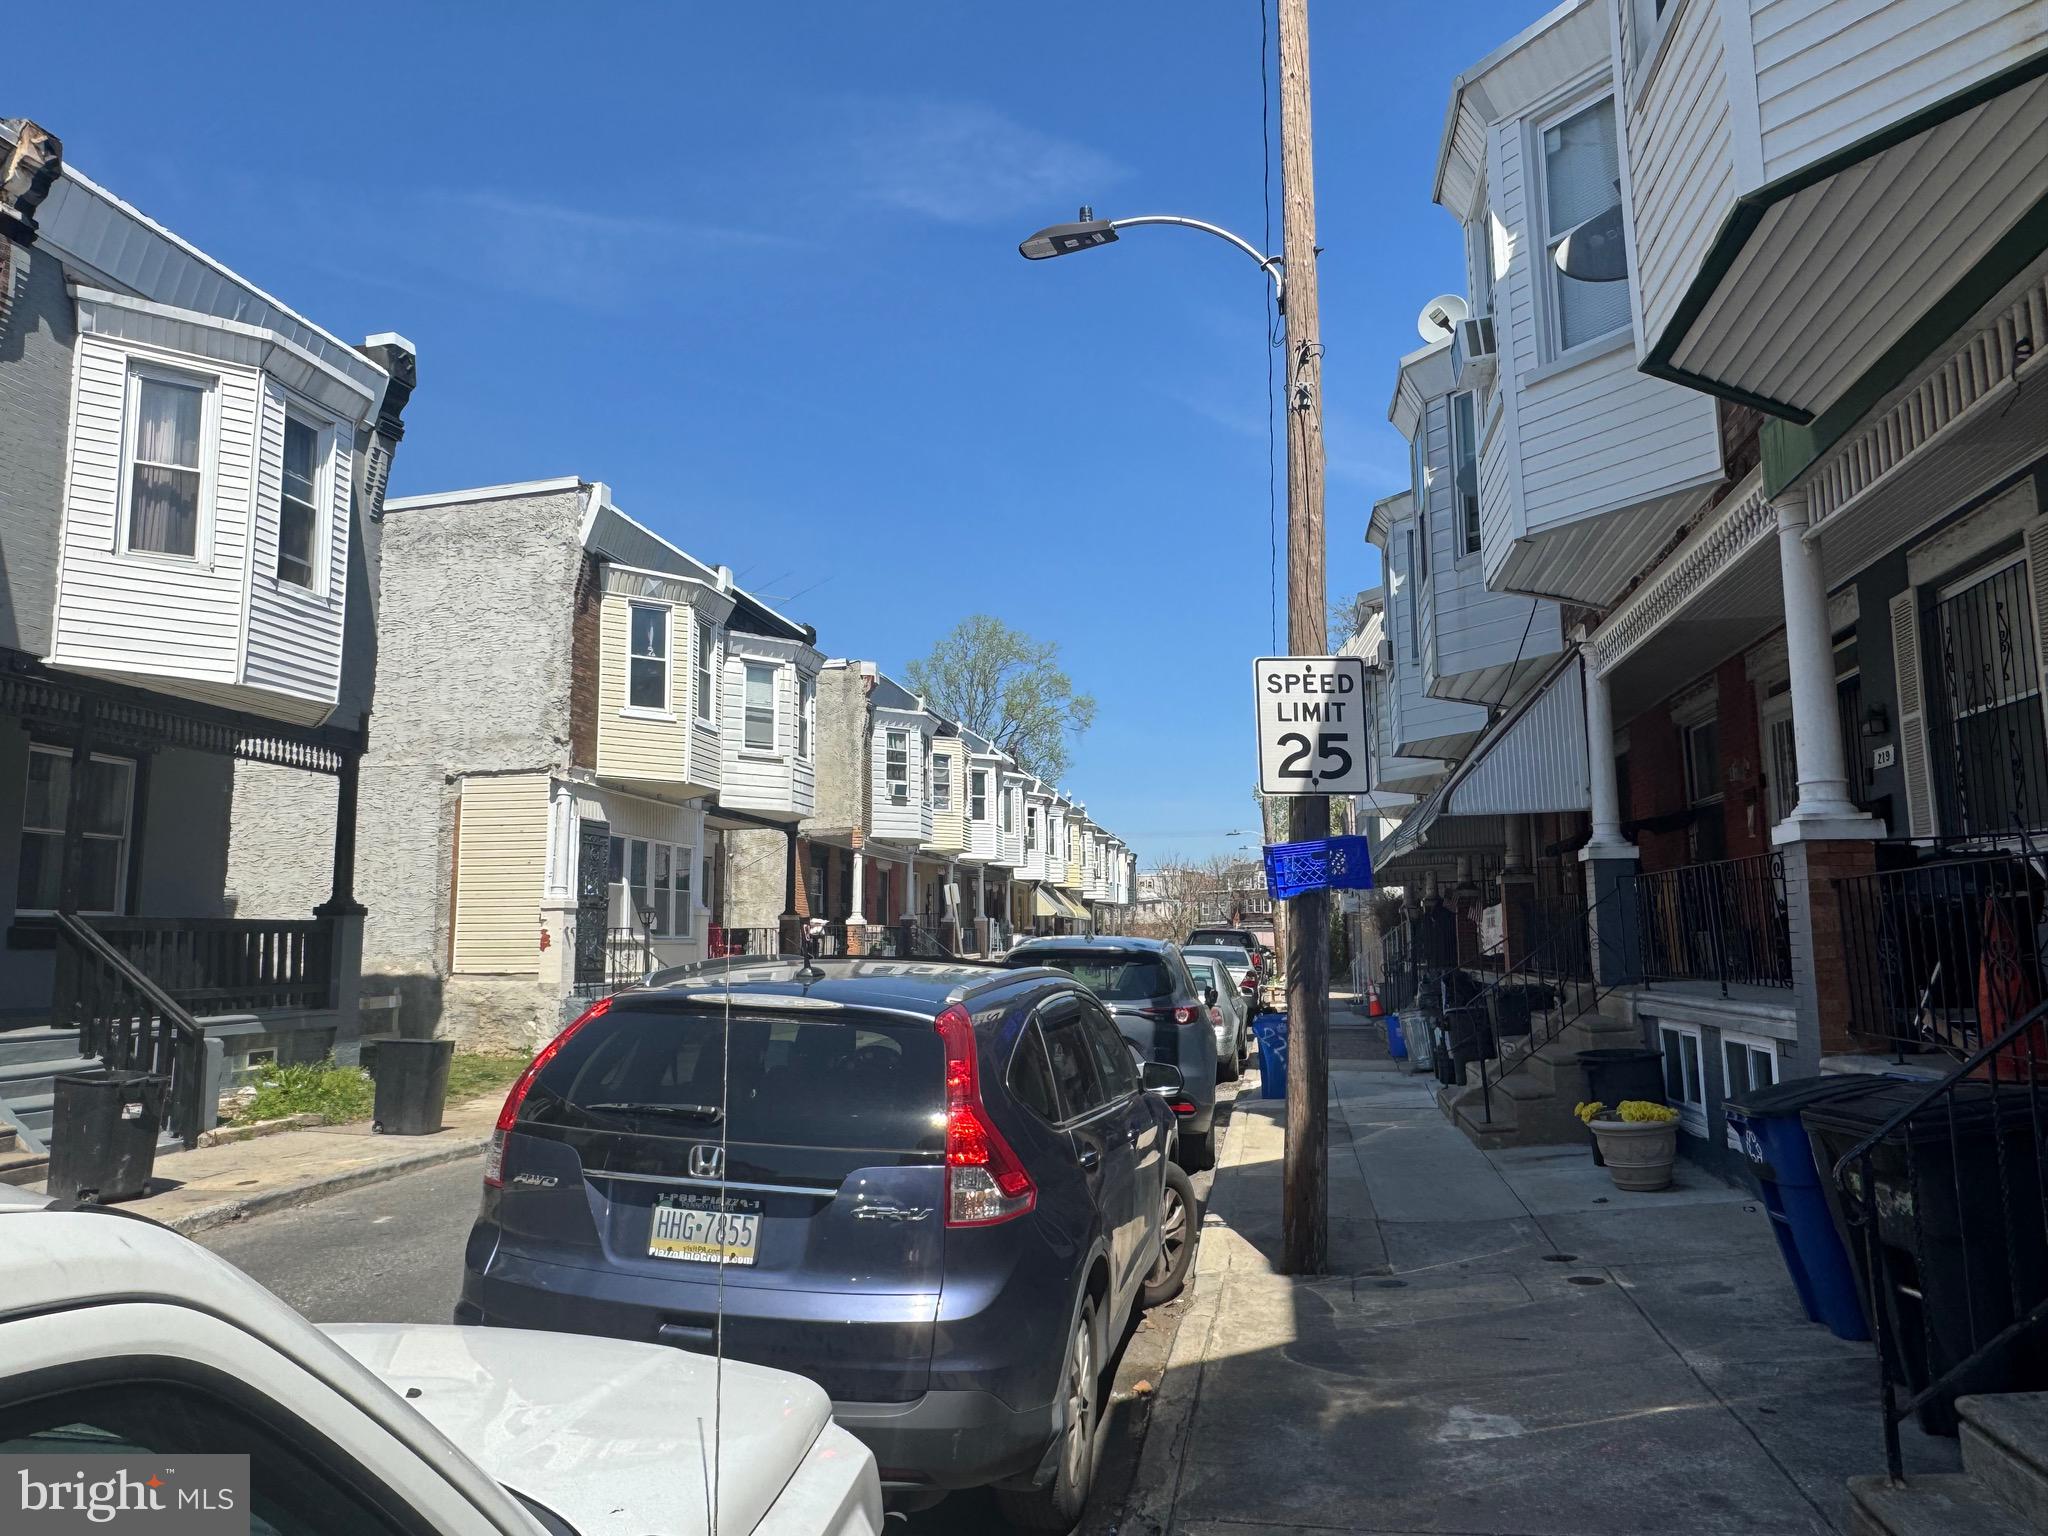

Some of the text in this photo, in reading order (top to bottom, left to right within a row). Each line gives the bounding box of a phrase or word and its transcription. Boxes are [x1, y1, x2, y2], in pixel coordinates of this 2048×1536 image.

[1267, 673, 1354, 694] SPEED
[1277, 702, 1346, 722] LIMIT
[1277, 732, 1352, 780] 25
[1877, 750, 1890, 765] 219
